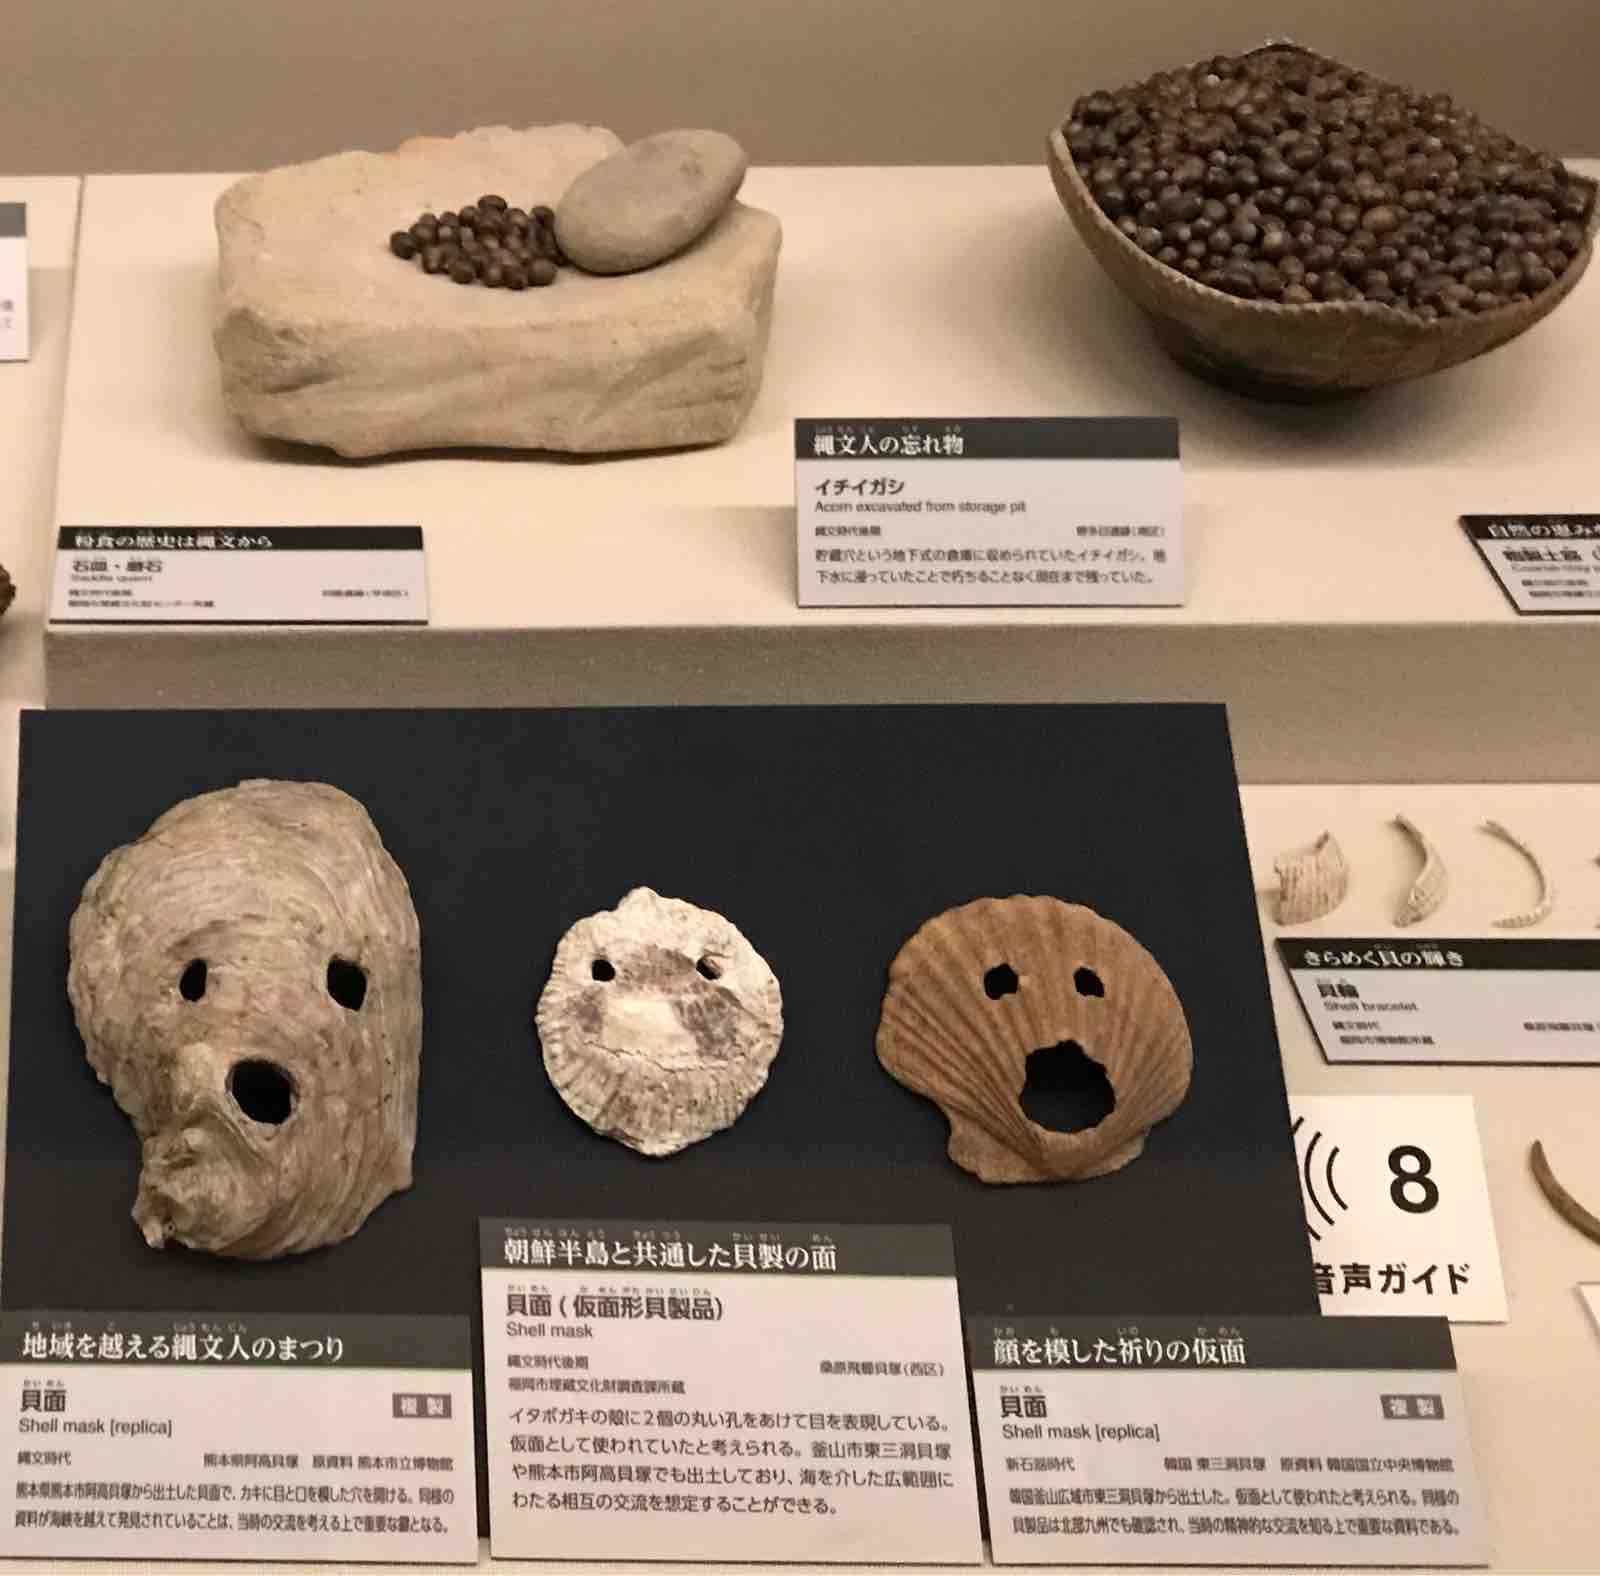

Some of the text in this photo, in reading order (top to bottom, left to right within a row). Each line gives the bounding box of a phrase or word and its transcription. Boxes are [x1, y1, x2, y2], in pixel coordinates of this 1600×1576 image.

[813, 434, 964, 456] 縄文人の忘れ物
[815, 478, 905, 496] イチイガシ
[815, 500, 1026, 516] Acorn excavated from storage pit
[1388, 1145, 1439, 1214] 8
[504, 1239, 837, 1271] 朝鮮半島と共通した貝製の面
[506, 1321, 593, 1338] Shell mask
[22, 1331, 344, 1361] 地域を越える縄文人のまつり
[993, 1338, 1247, 1365] 顔を模した祈りの仮面
[507, 1354, 589, 1369] 縄文時代後期
[20, 1389, 66, 1412] 貝面
[1000, 1395, 1047, 1418] 貝面
[19, 1418, 172, 1437] Shell mask [replica]
[1002, 1423, 1160, 1442] Shell mask [replica]
[17, 1451, 72, 1466] 縄文時代
[512, 1491, 838, 1515] わたる相互の交流を想定することができる。
